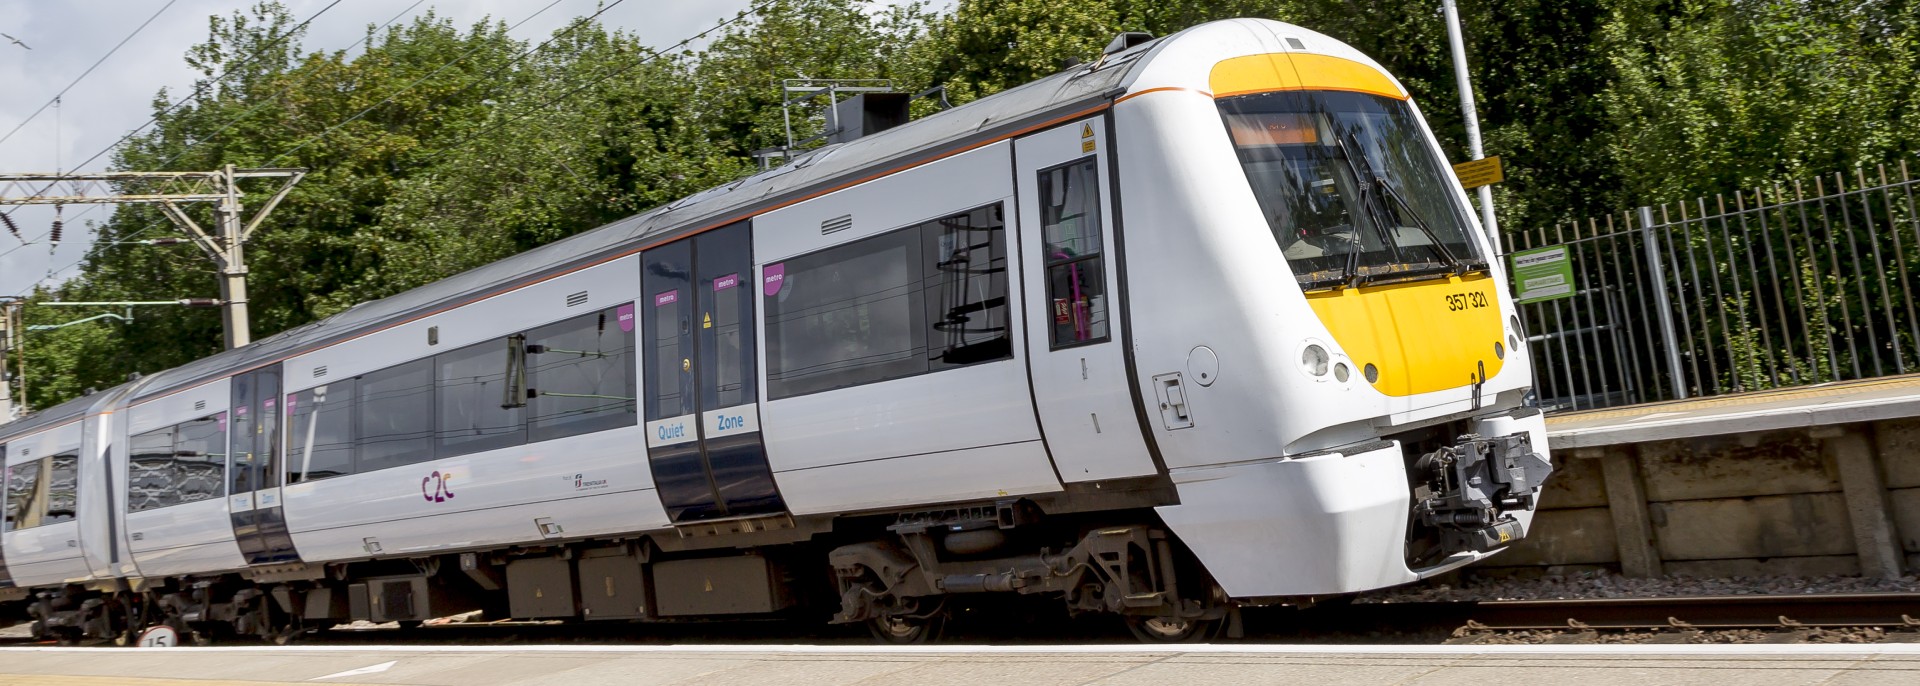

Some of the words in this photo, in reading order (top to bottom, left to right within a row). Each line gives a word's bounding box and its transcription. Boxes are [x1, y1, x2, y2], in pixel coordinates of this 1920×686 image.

[718, 278, 735, 288] metro
[766, 273, 783, 284] metro
[659, 294, 675, 304] metro
[1445, 293, 1468, 312] 357
[1468, 290, 1489, 308] 321
[619, 313, 633, 322] metro
[658, 422, 684, 441] Quiet
[717, 414, 744, 431] Zone
[422, 470, 455, 503] c2c
